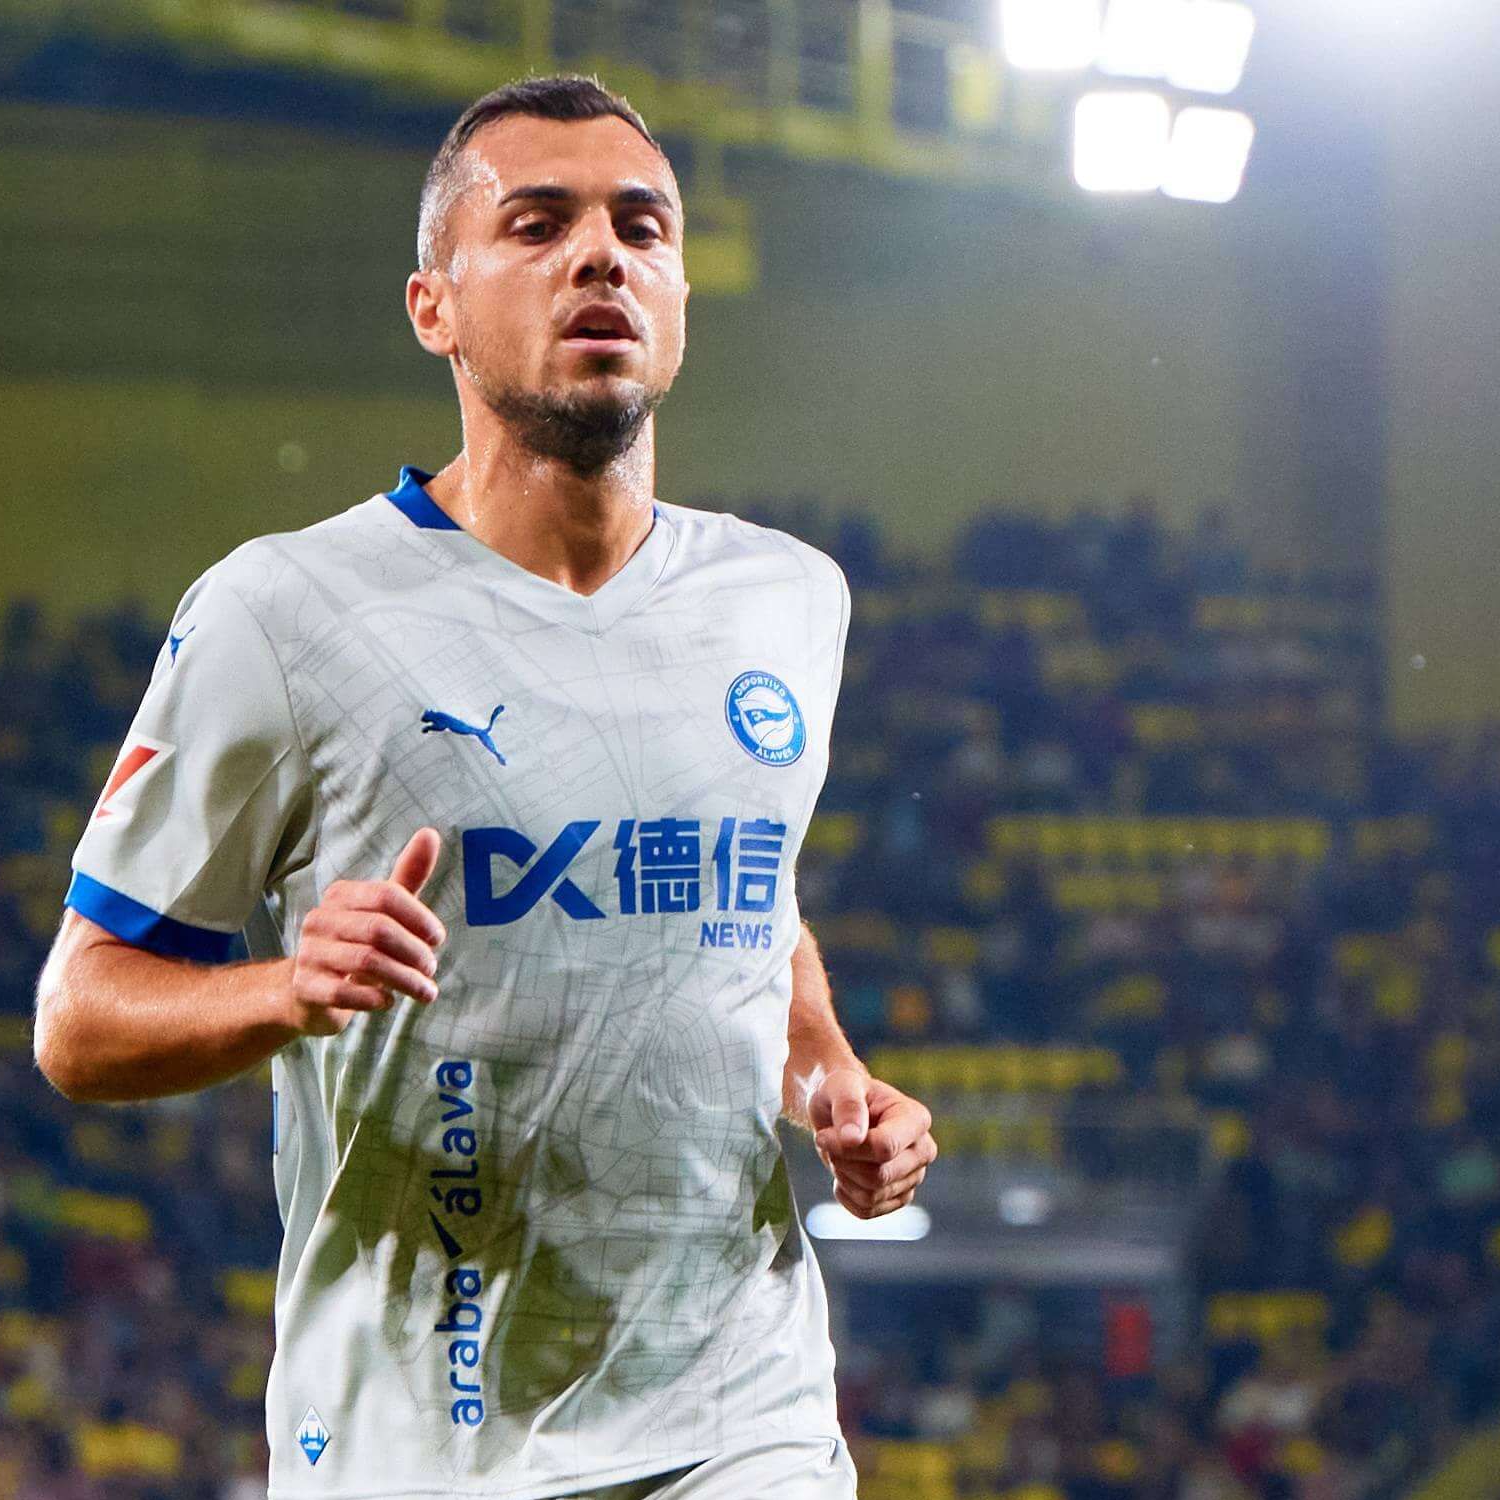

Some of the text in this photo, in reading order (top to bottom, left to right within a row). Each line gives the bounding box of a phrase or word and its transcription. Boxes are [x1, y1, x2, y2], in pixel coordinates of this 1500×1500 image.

[735, 676, 786, 696] DEPORTIVO
[612, 816, 788, 915] 德信
[700, 922, 773, 950] NEWS
